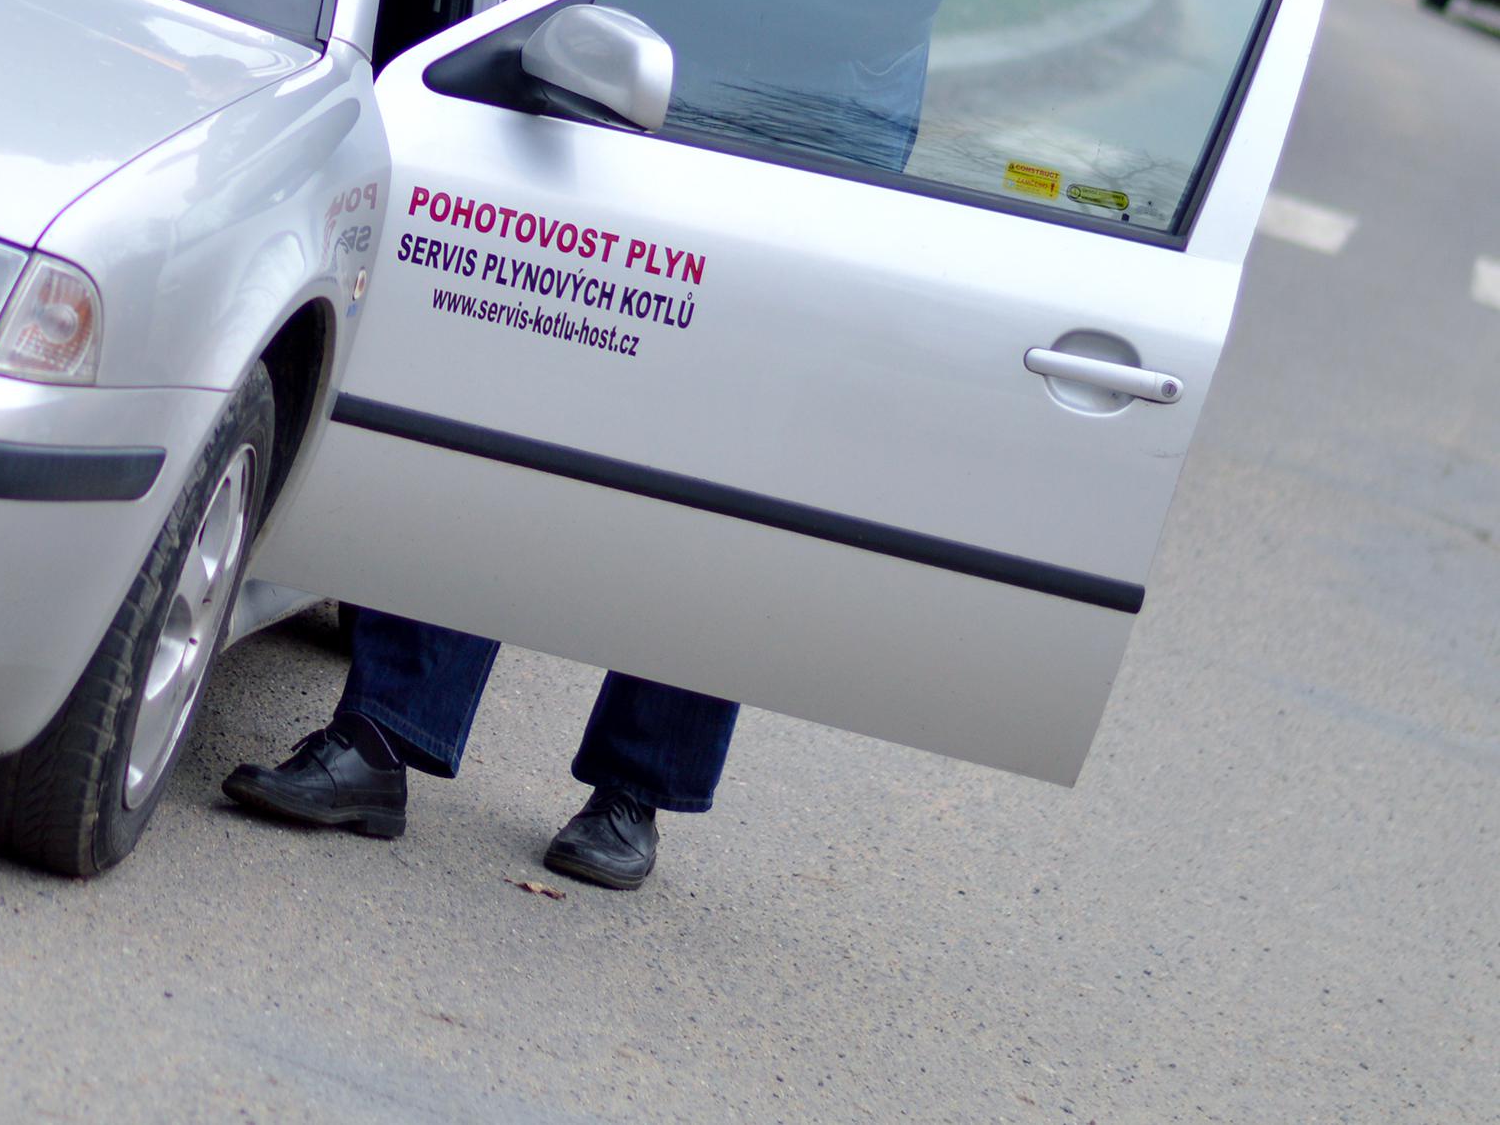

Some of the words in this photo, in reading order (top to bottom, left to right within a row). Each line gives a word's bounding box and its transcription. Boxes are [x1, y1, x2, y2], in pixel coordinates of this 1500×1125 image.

[397, 233, 478, 278] SERVIS
[482, 253, 615, 311] PLYNOVÝCH
[619, 286, 695, 329] KOTLŮ
[408, 186, 619, 264] POHOTOVOST
[625, 239, 706, 285] PLYN
[432, 287, 640, 357] www.servis-kotlu-host.cz
